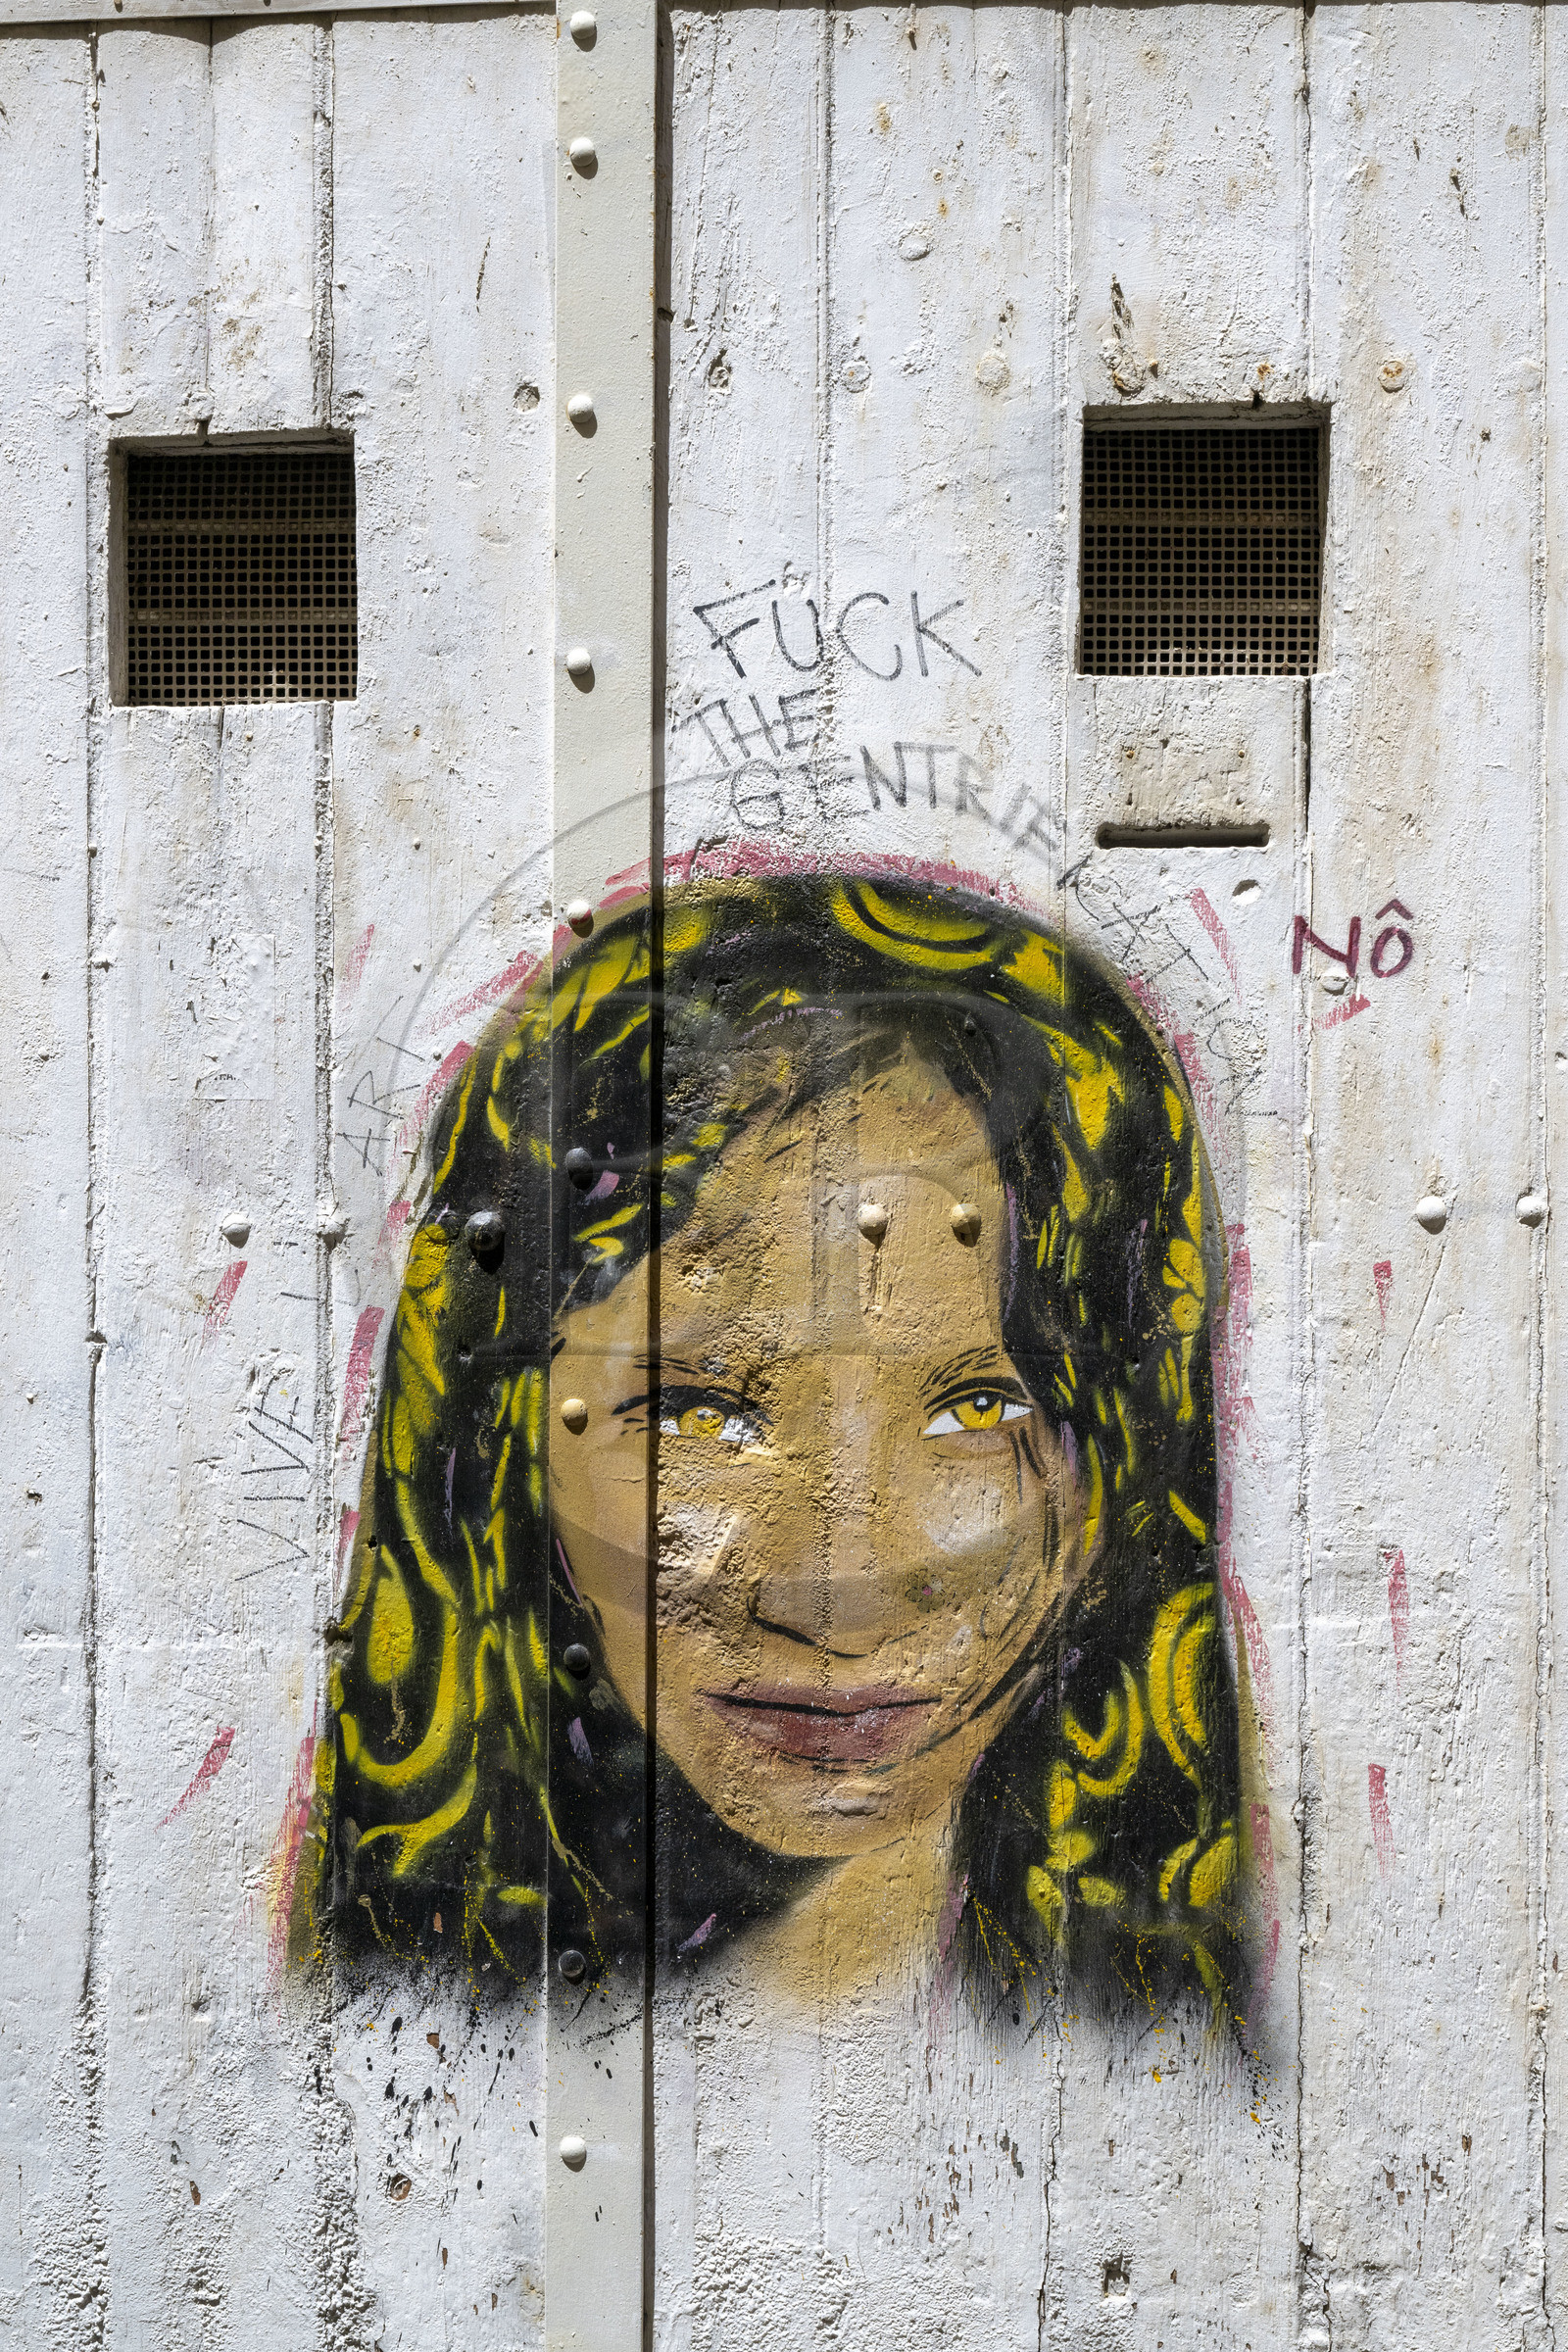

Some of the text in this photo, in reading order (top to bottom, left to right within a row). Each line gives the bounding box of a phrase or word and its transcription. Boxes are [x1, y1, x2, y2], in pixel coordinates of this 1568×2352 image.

[693, 579, 983, 680] FUCK
[671, 689, 820, 766] THE
[1292, 899, 1414, 978] NÔ
